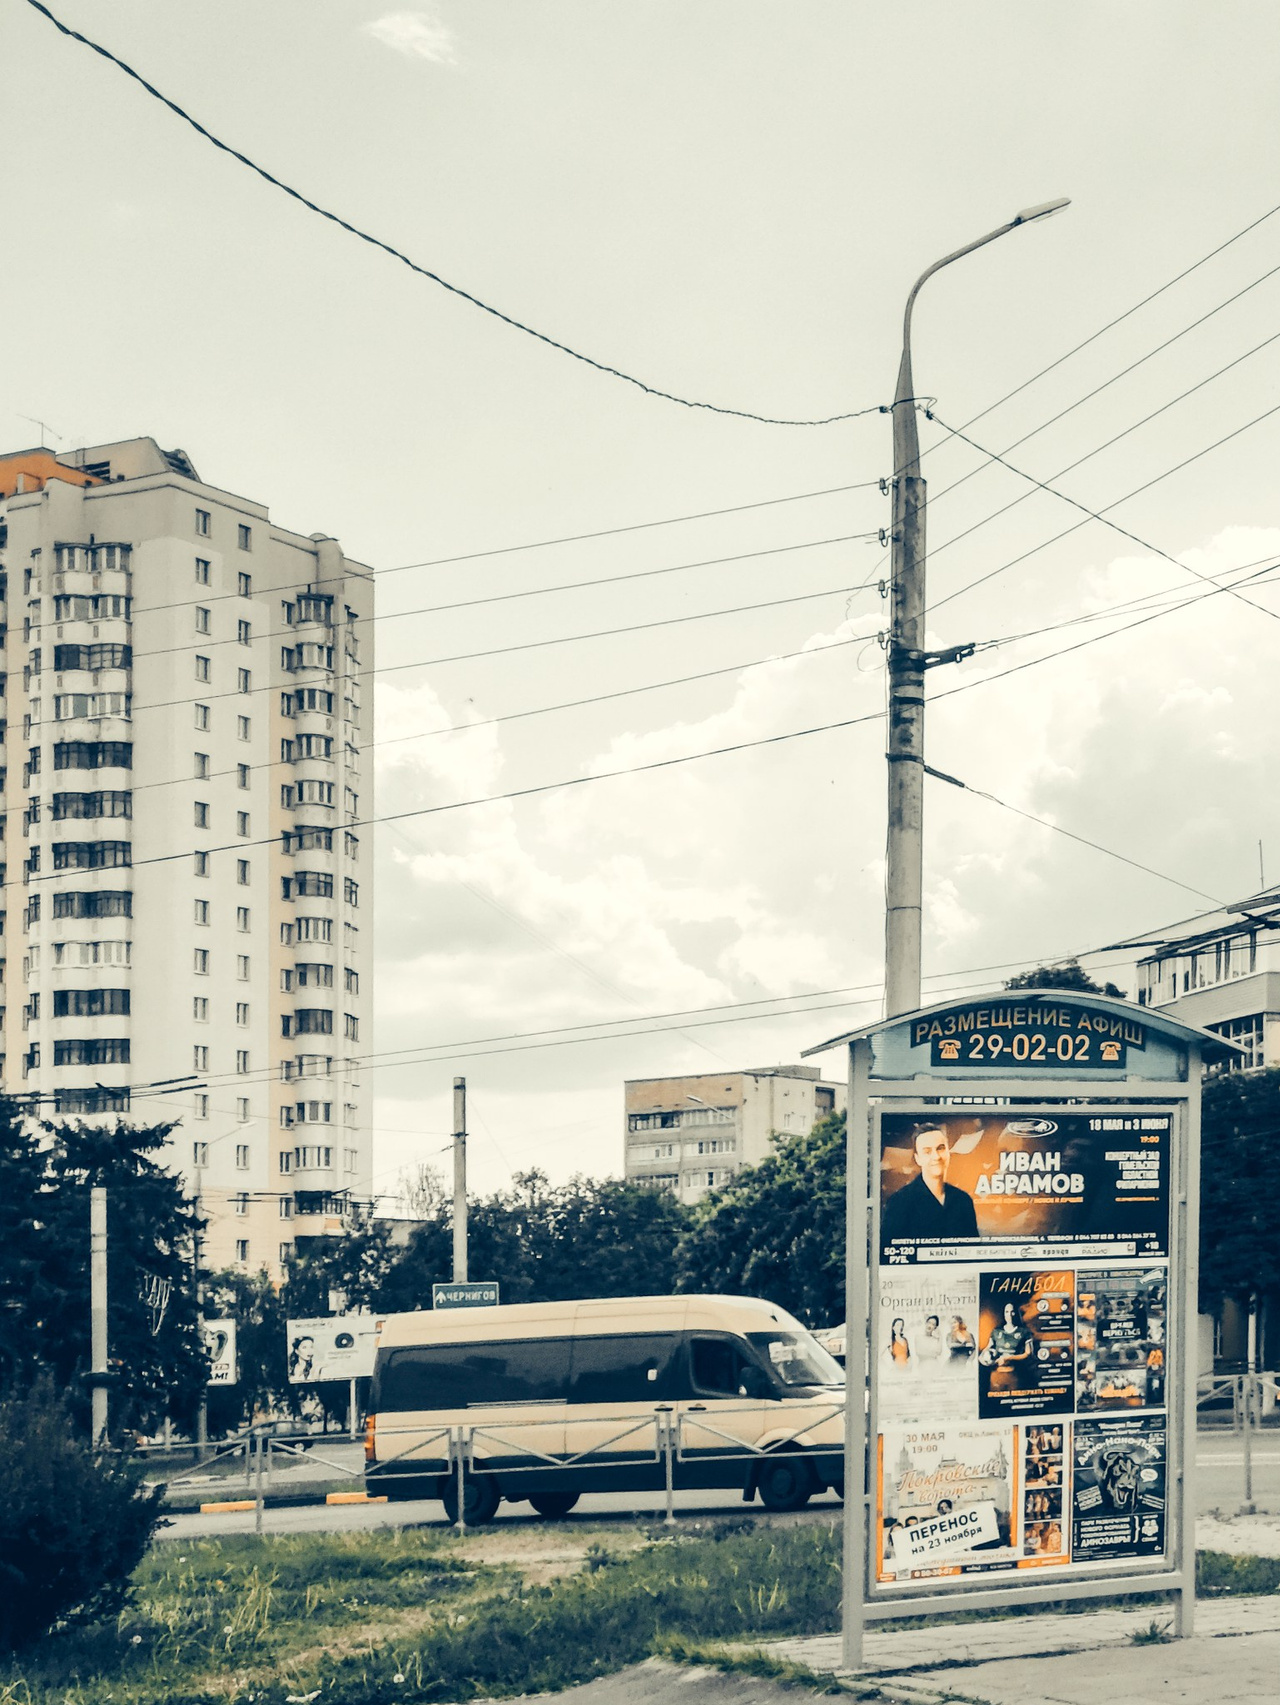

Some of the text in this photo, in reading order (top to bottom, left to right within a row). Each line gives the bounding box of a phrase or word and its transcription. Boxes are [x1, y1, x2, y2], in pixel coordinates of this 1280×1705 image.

[915, 1006, 1143, 1046] РАЗМЕЩЕНИЕ АФИШ
[968, 1033, 1090, 1061] 29-02-02
[1089, 1118, 1101, 1131] 18
[1132, 1118, 1140, 1130] 3
[1000, 1151, 1061, 1172] ИВАН
[974, 1173, 1085, 1195] АБРАМОВ
[989, 1275, 1067, 1294] ГАНДБОЛ
[446, 1290, 496, 1302] ЧЕРНИГОВ
[880, 1293, 977, 1311] Орган и Дуэты
[905, 1431, 945, 1443] 30 МАЯ
[912, 1445, 938, 1454] 19:00
[897, 1457, 1001, 1492] Покровские
[909, 1511, 979, 1542] ПЕРЕНОС
[911, 1525, 983, 1555] на 23 ноября
